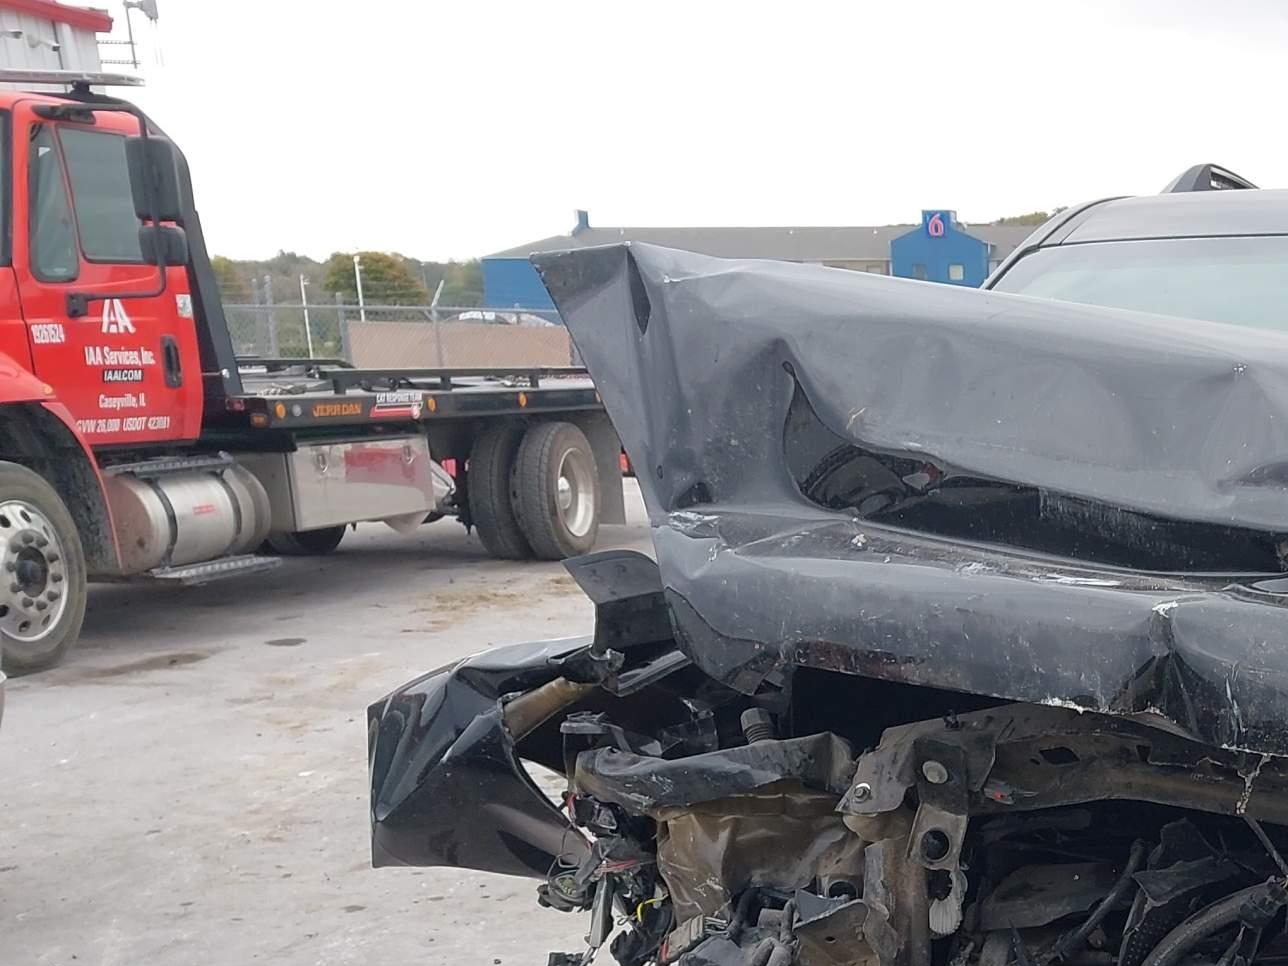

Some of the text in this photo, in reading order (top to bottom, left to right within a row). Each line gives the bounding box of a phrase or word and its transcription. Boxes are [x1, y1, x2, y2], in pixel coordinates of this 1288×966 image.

[928, 213, 944, 237] 6
[84, 346, 103, 366] IAA
[122, 417, 148, 431] USDOT
